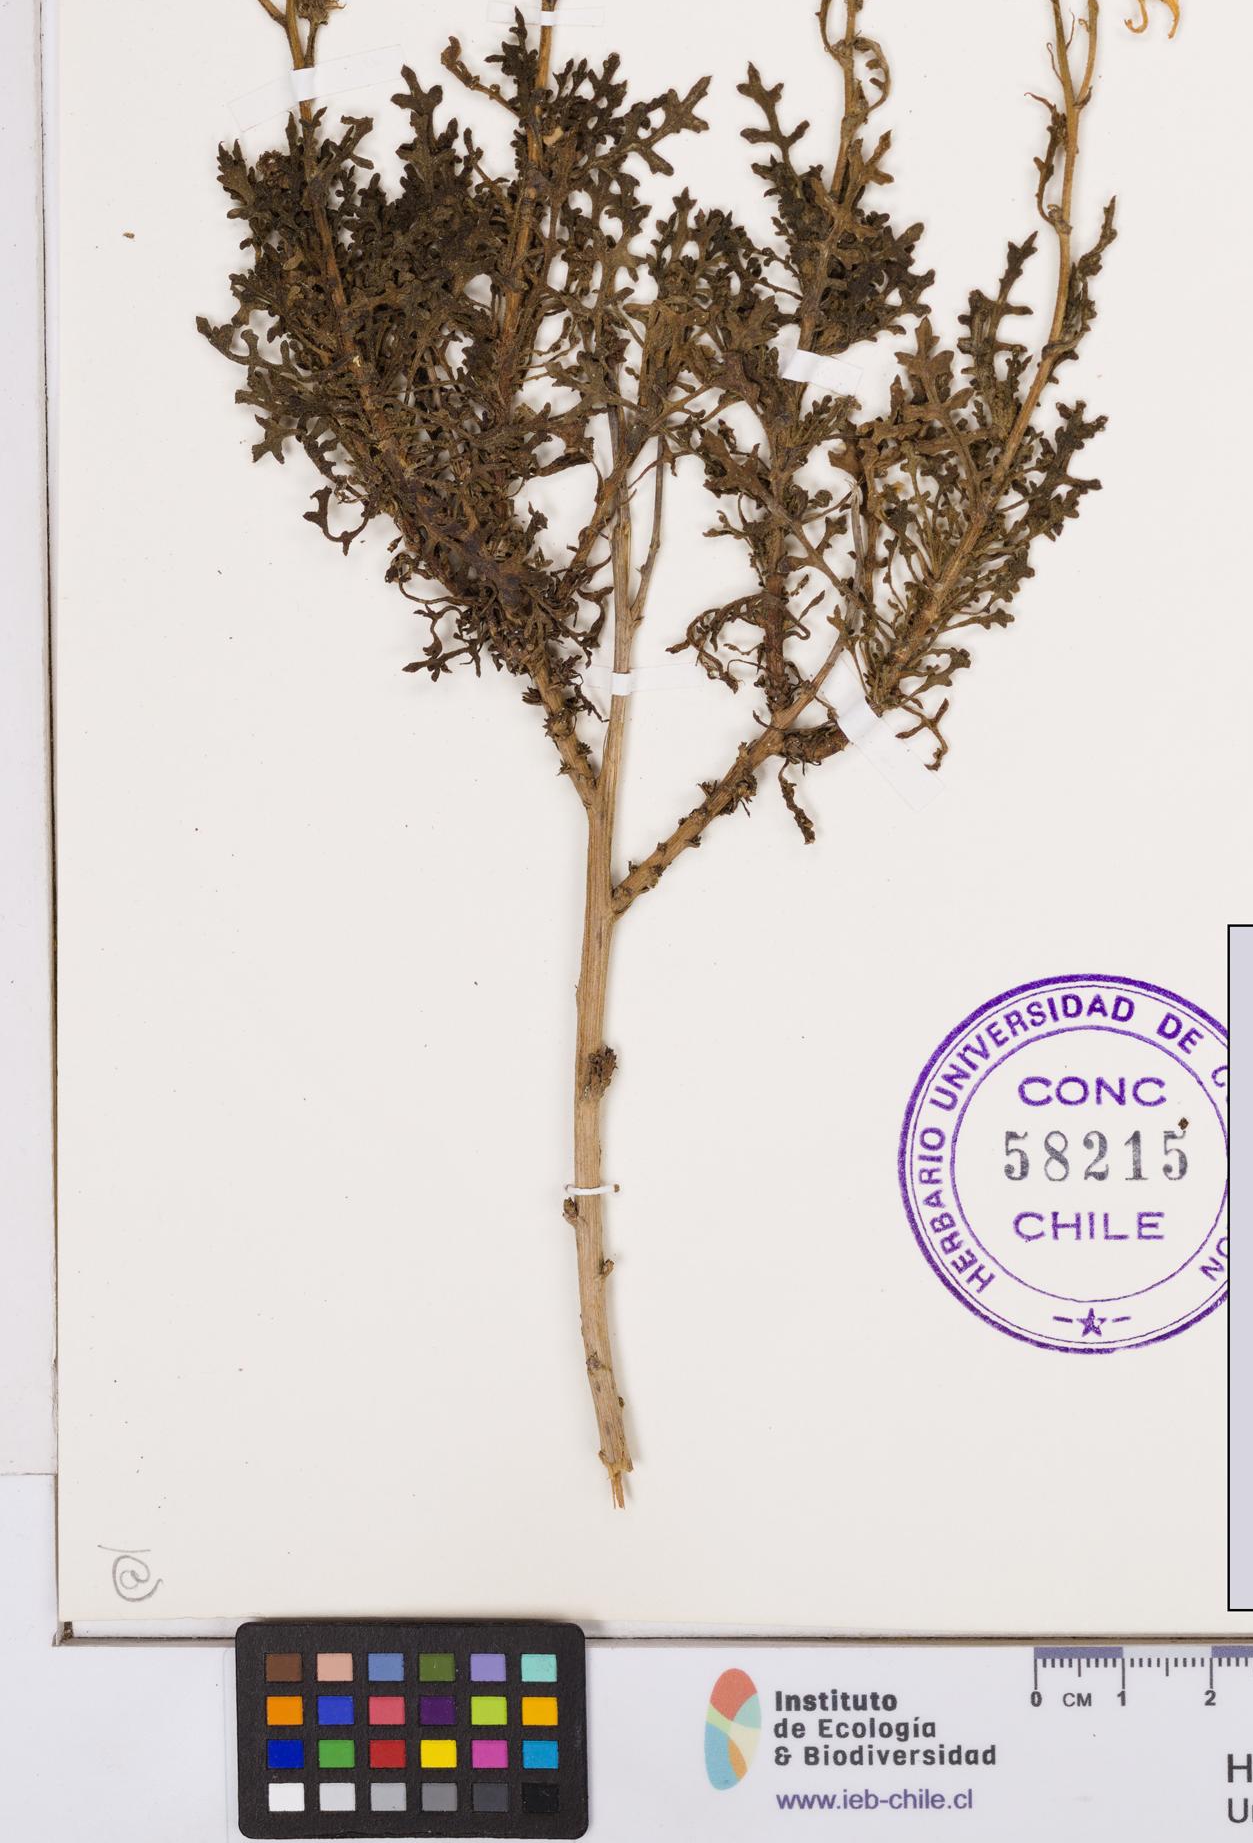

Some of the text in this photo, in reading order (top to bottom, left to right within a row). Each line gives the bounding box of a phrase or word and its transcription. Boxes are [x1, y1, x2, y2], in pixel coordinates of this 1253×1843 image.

[1017, 1075, 1168, 1108] CONC
[917, 993, 1205, 1294] HERBARIO UNIVERSIDAD DE
[1003, 1129, 1189, 1182] 58215
[1012, 1210, 1166, 1241] CHILE
[775, 1689, 898, 1712] Instituto
[1030, 1690, 1043, 1708] 0
[1062, 1692, 1093, 1708] CM
[1117, 1690, 1127, 1707] 1
[1204, 1689, 1217, 1707] 2
[773, 1716, 936, 1742] de Ecología
[774, 1743, 997, 1766] & Biodiversidad
[775, 1788, 973, 1810] www.ieb-chile.cl
